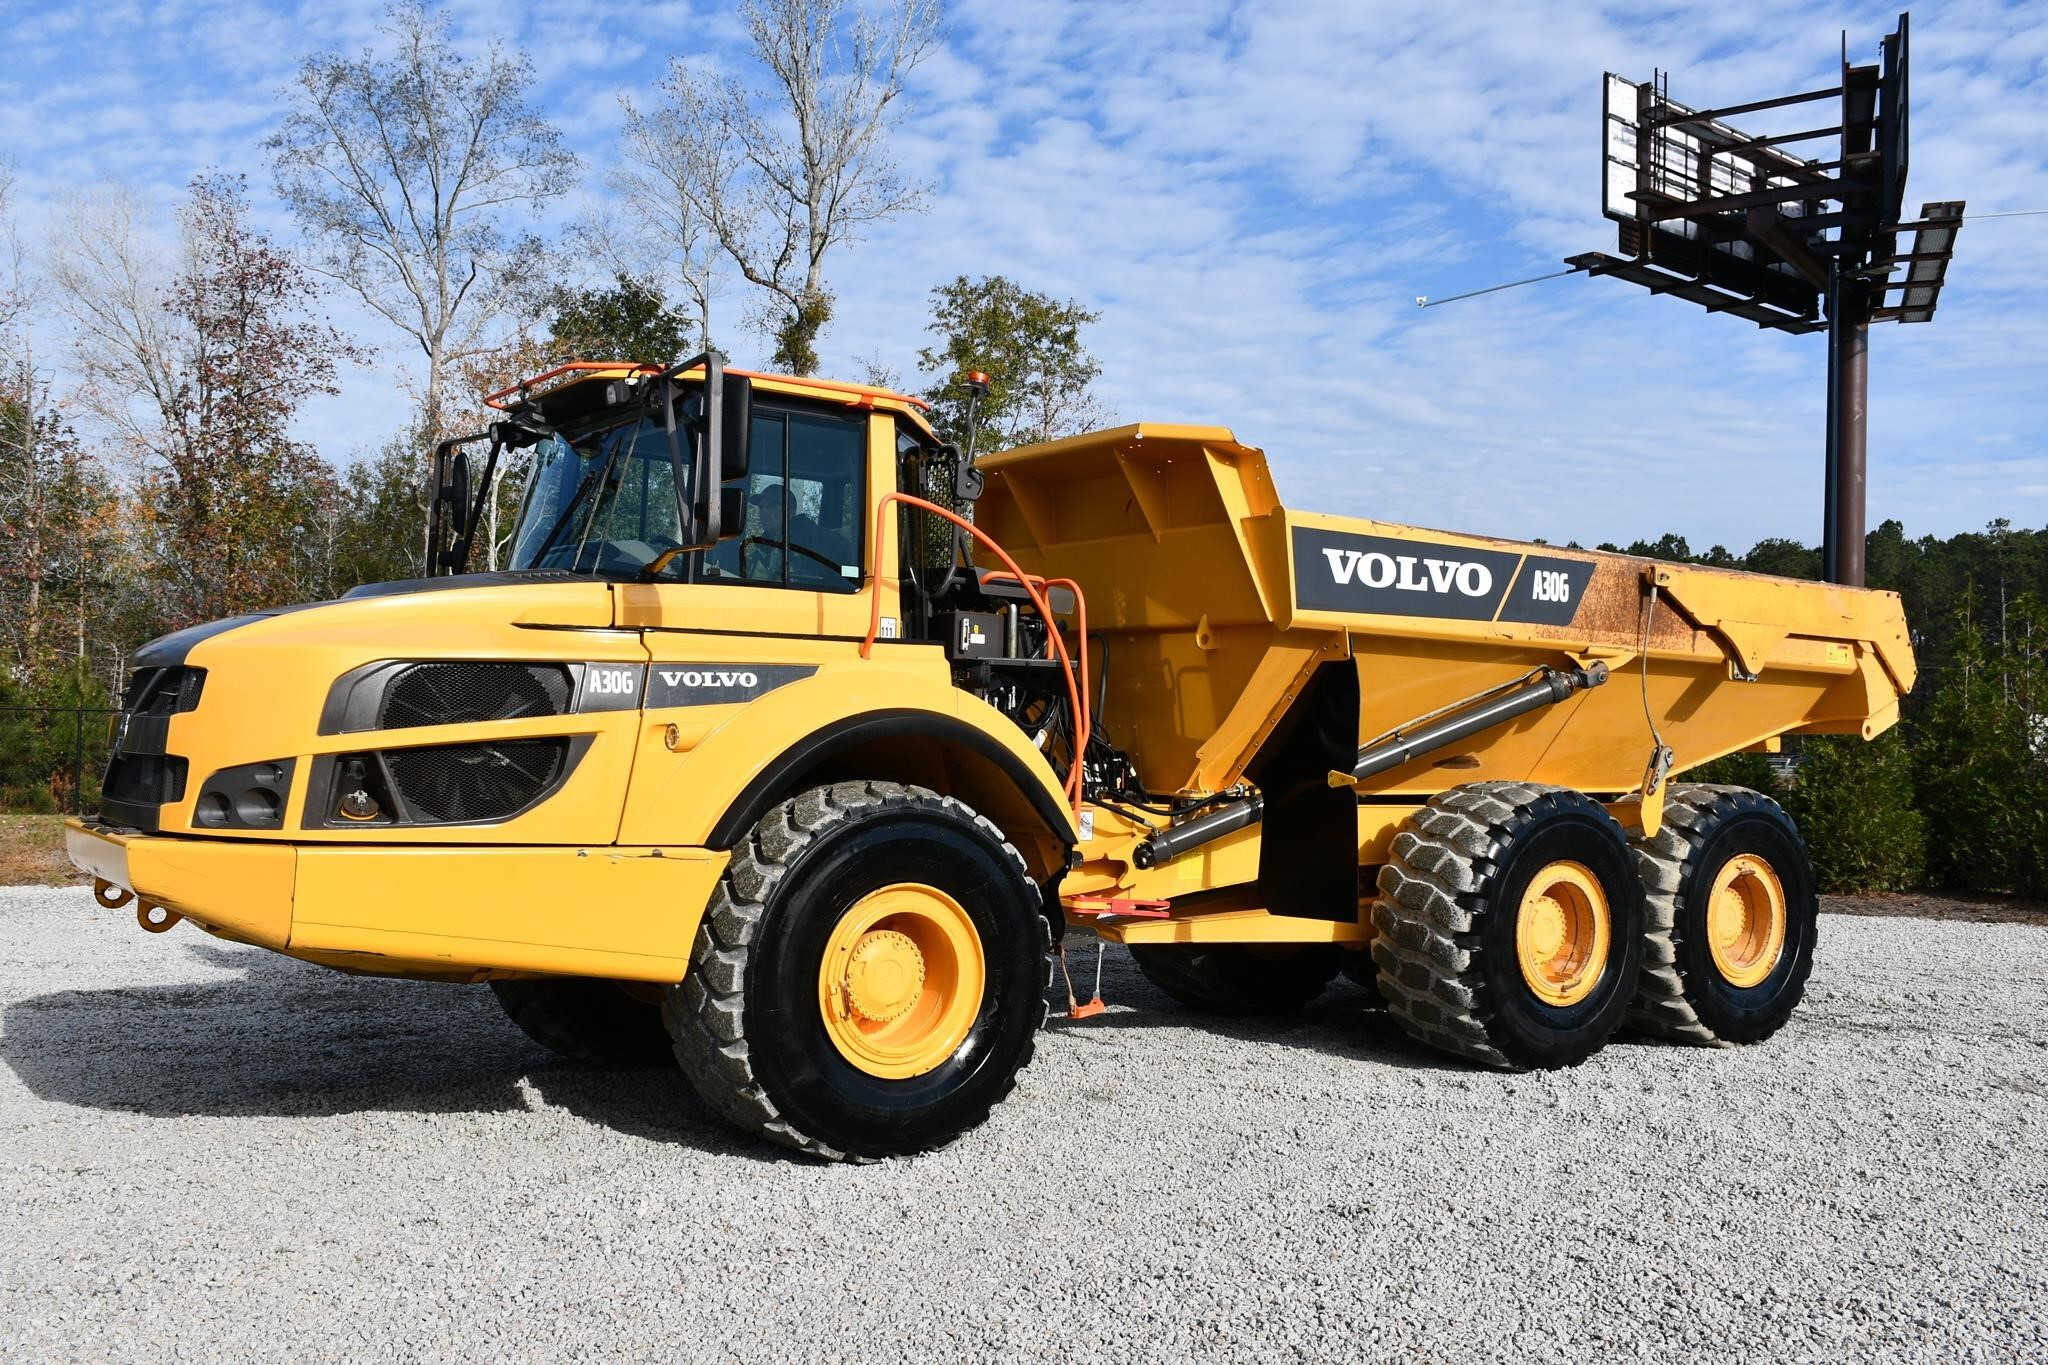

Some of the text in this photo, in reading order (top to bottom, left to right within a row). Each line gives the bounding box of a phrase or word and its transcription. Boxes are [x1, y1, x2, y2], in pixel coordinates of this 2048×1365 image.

[1322, 548, 1492, 597] VOLVO
[1532, 570, 1569, 602] A30G
[589, 670, 634, 694] A30G
[659, 671, 758, 687] VOLVO
